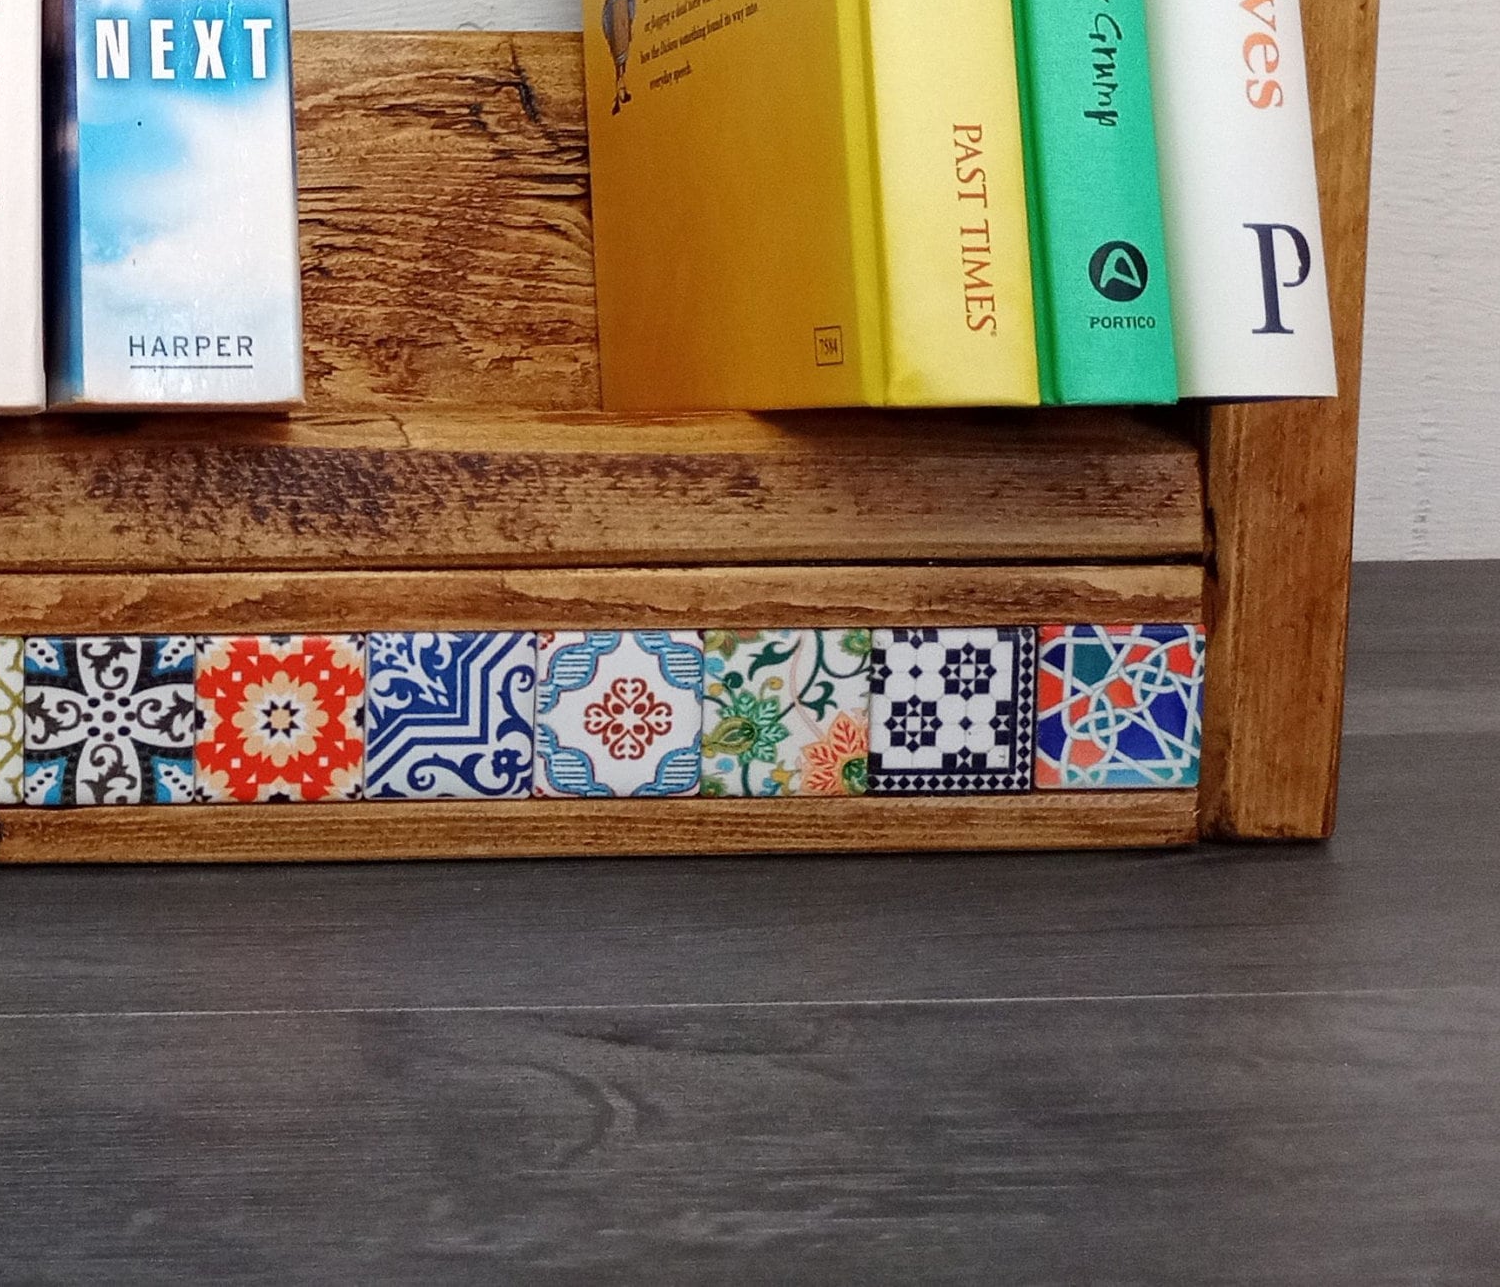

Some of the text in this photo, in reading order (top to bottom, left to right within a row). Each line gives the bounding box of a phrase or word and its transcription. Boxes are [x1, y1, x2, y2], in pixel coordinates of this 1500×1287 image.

[94, 18, 273, 81] NEXT
[1083, 12, 1123, 127] Grump
[953, 123, 988, 208] PAST
[1242, 222, 1311, 336] P
[128, 335, 254, 357] HARPER
[1089, 316, 1156, 329] PORTICO
